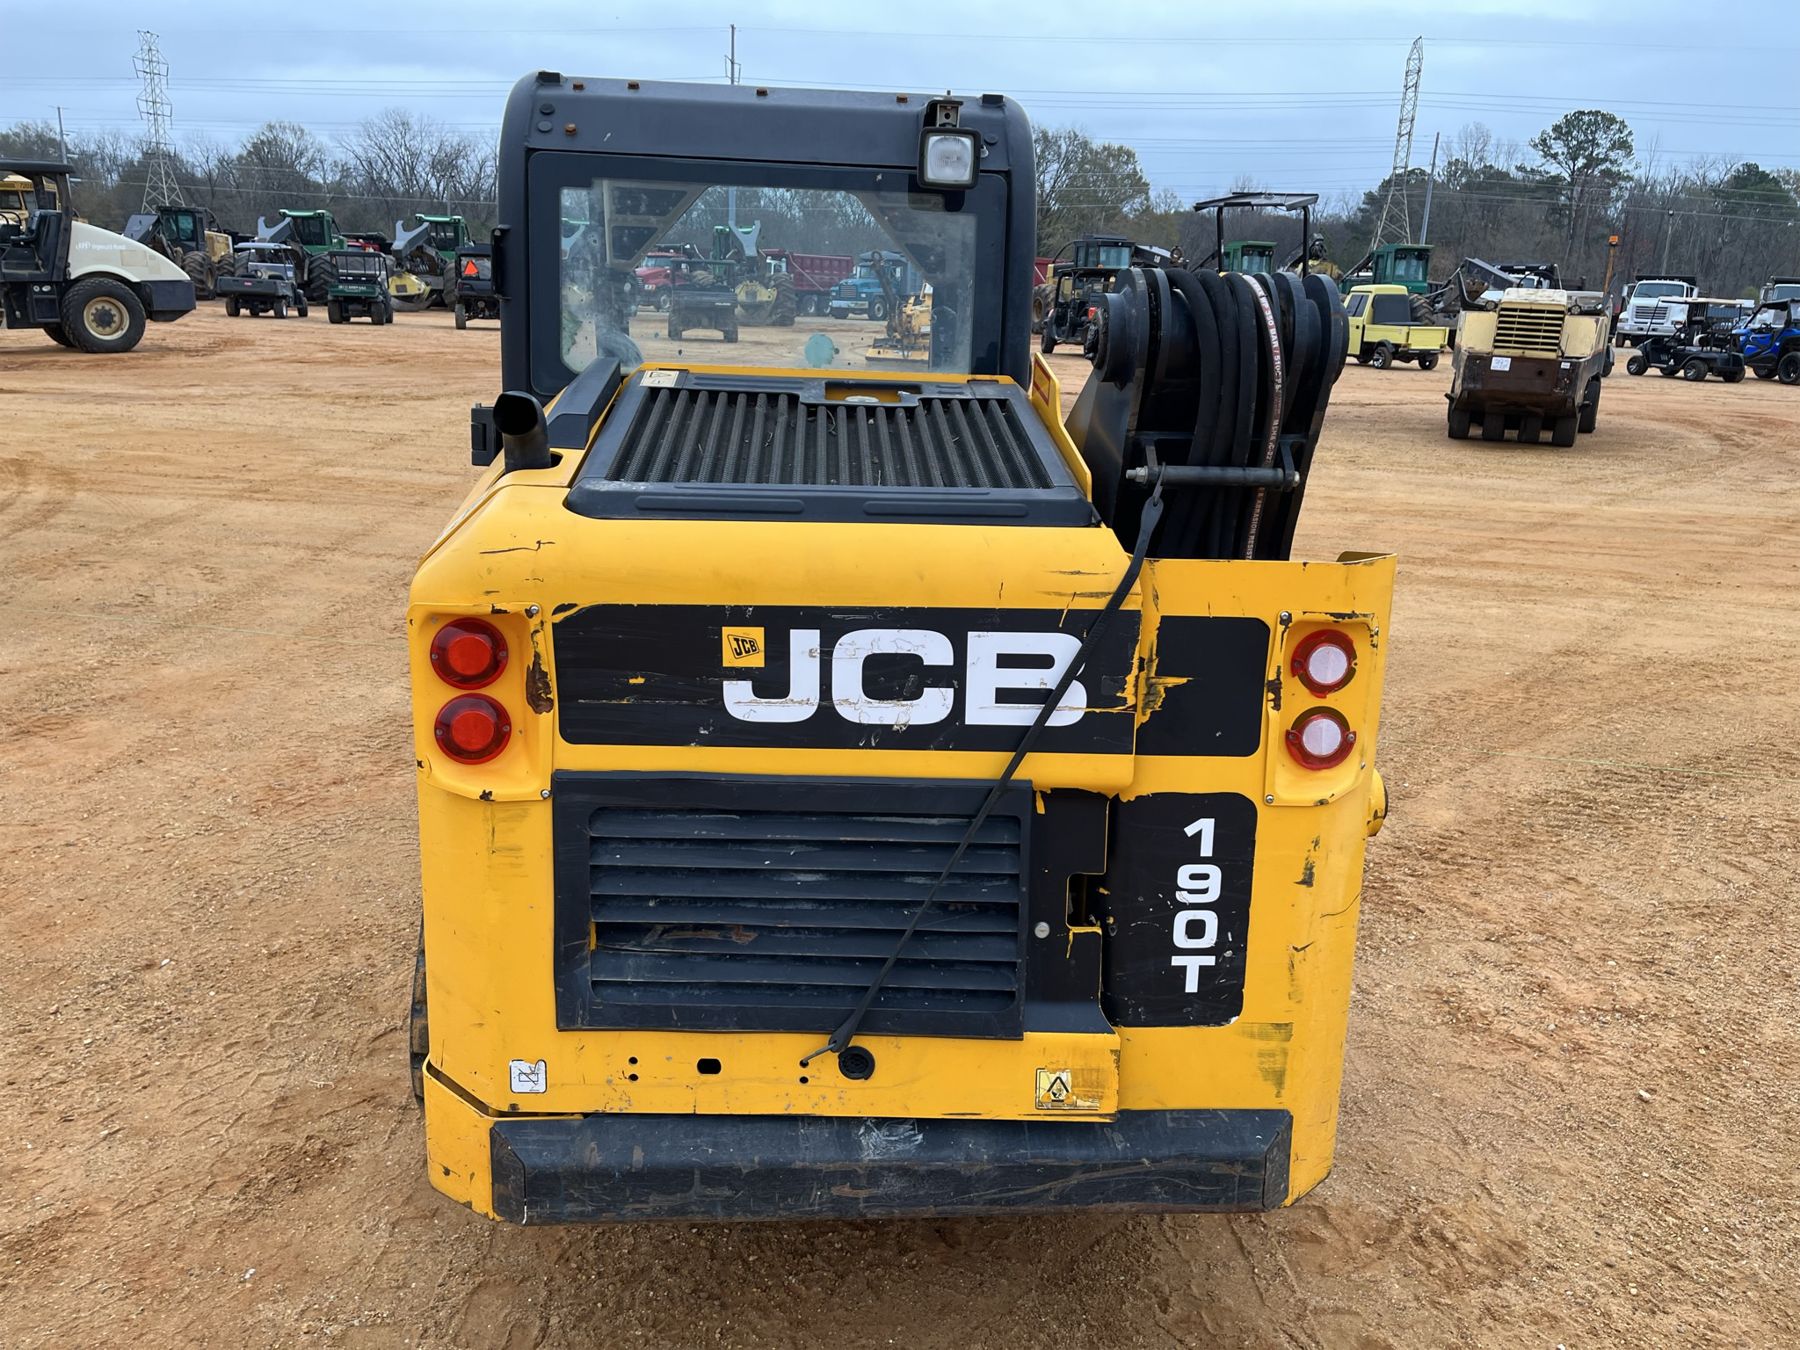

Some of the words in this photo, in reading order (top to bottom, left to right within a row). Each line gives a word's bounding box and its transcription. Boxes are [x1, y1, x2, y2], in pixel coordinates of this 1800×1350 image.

[1268, 328, 1279, 347] BAR
[1244, 535, 1256, 560] RESIST
[733, 637, 757, 656] JCB
[723, 629, 1087, 726] JCB
[1171, 817, 1222, 993] 190T
